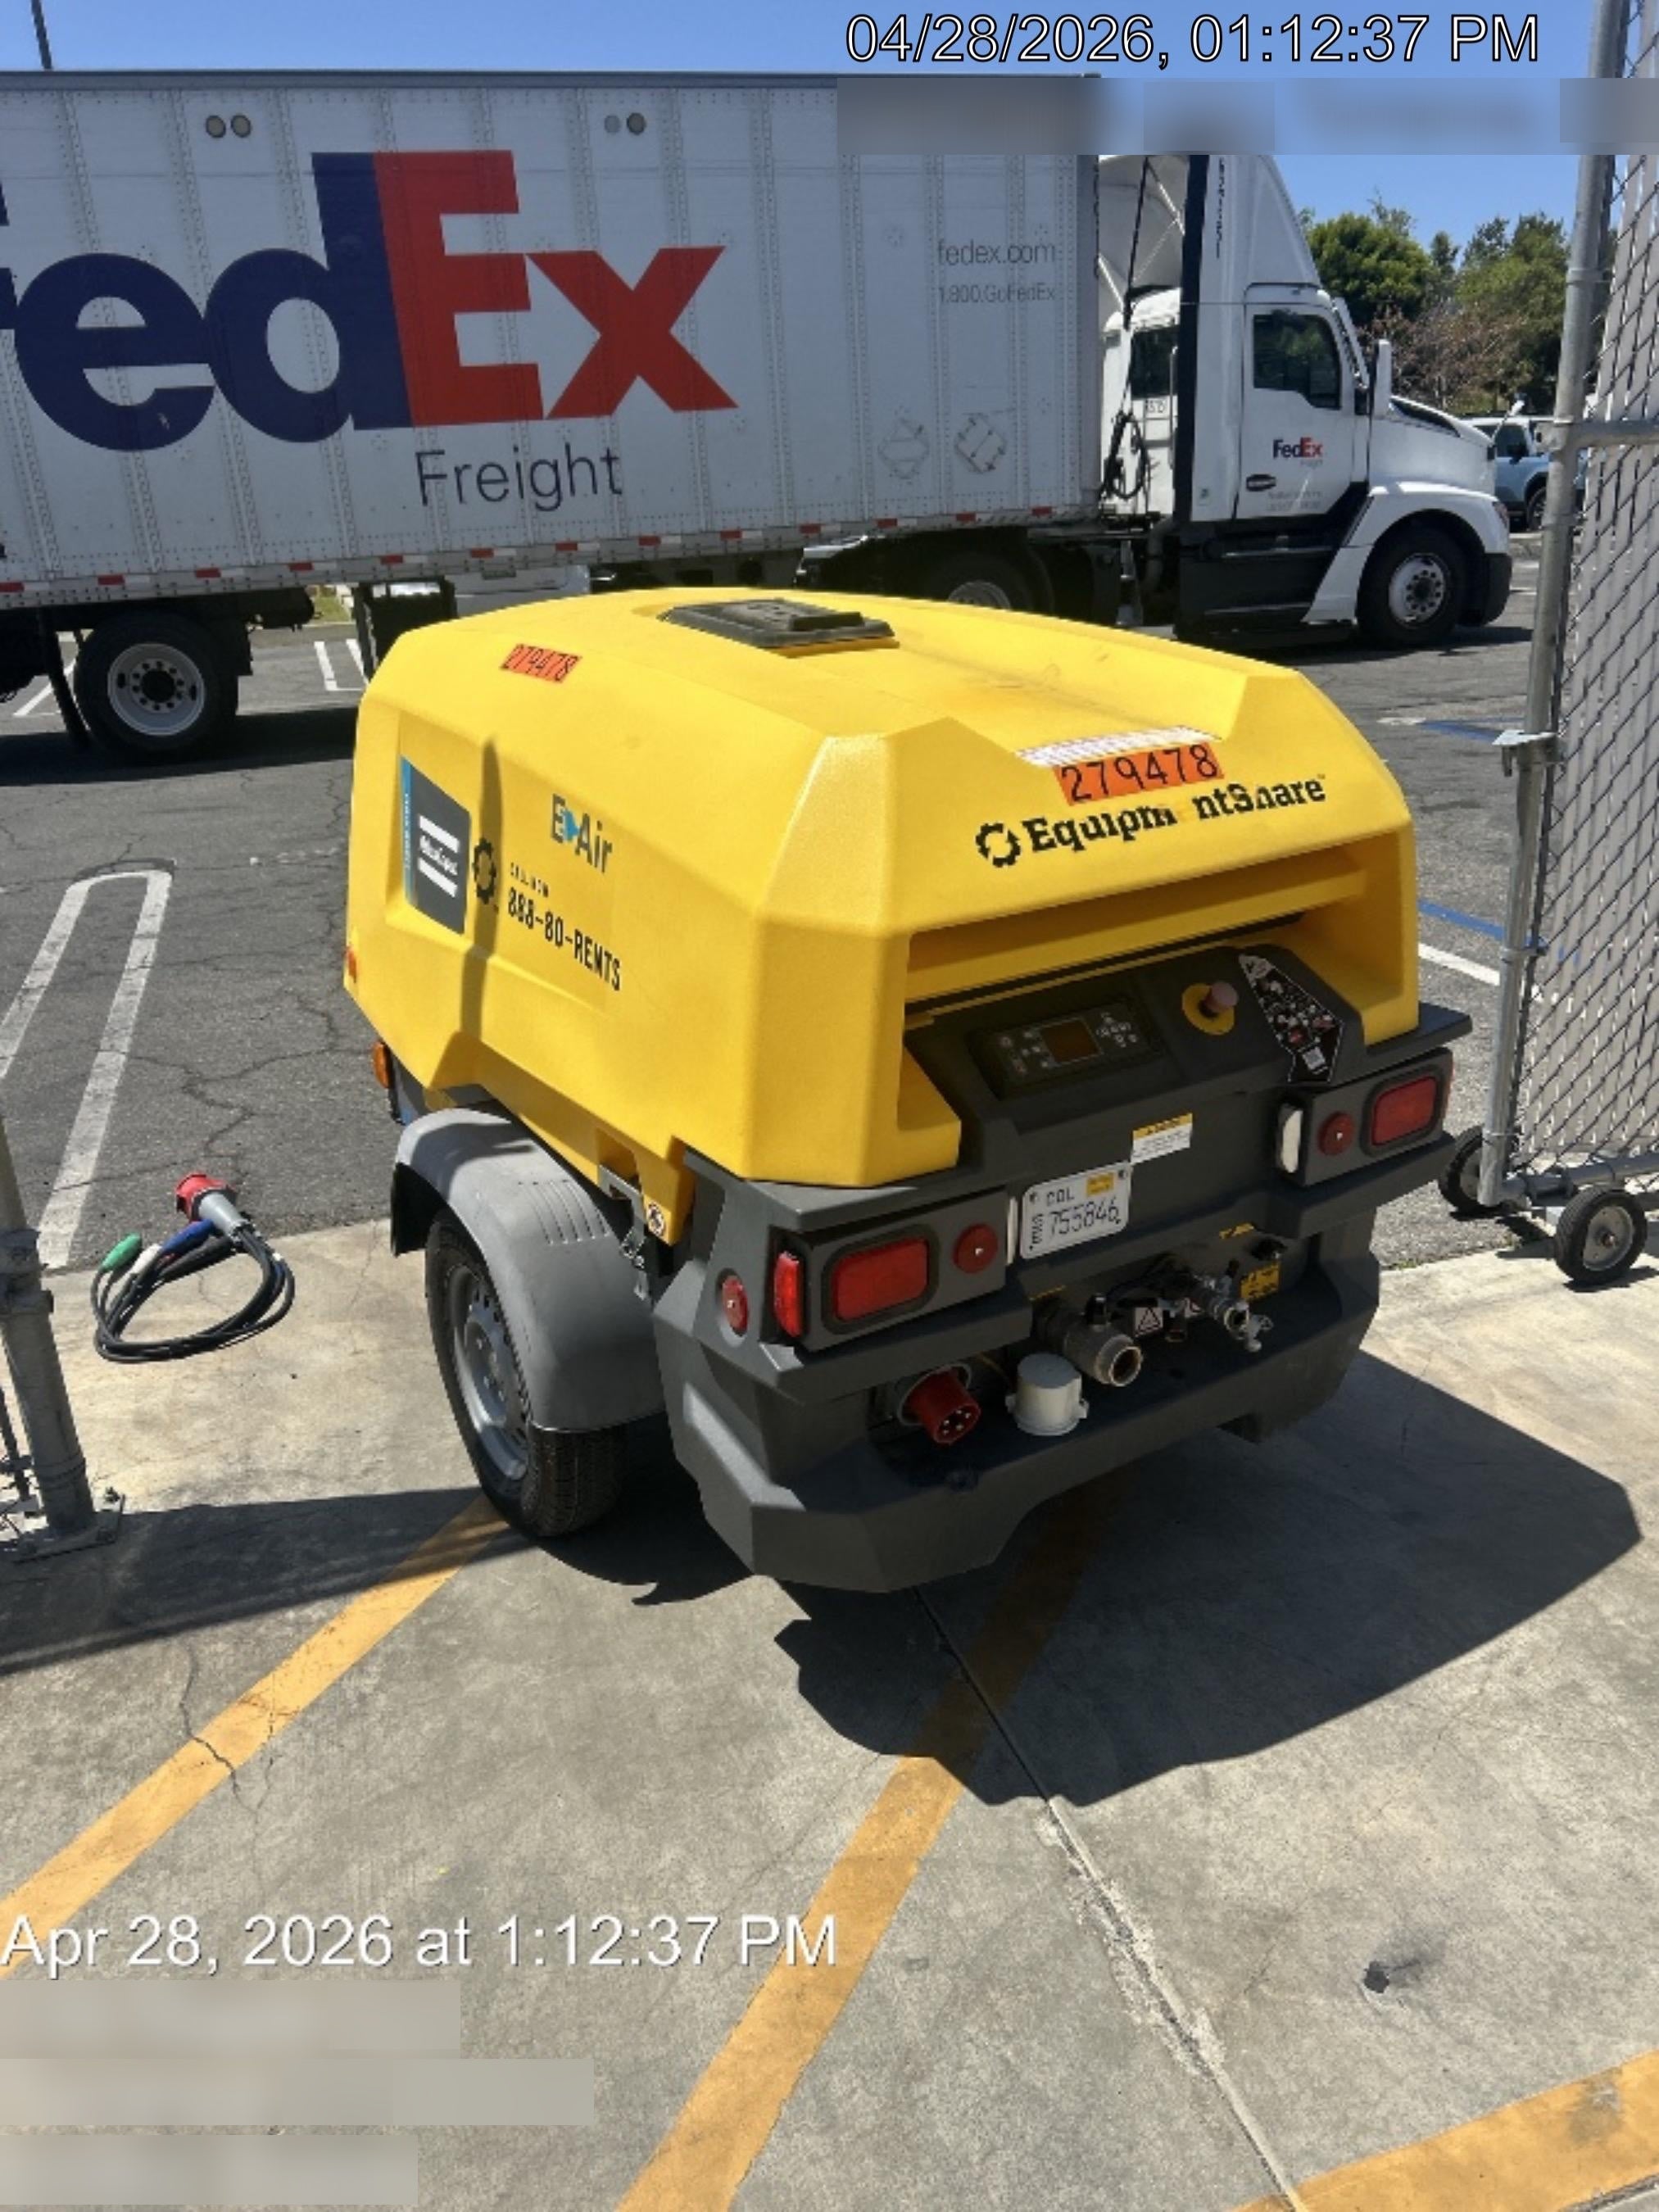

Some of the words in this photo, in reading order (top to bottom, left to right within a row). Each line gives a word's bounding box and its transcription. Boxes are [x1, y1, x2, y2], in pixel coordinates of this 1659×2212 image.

[938, 238, 1056, 266] fedex.com
[0, 150, 739, 451] edEx
[1272, 437, 1324, 459] FedEx
[415, 442, 623, 511] Freight
[500, 643, 581, 682] 279478
[1061, 744, 1218, 803] 279478
[507, 886, 621, 991] 888-80-RENTS
[1049, 1196, 1120, 1236] 755846
